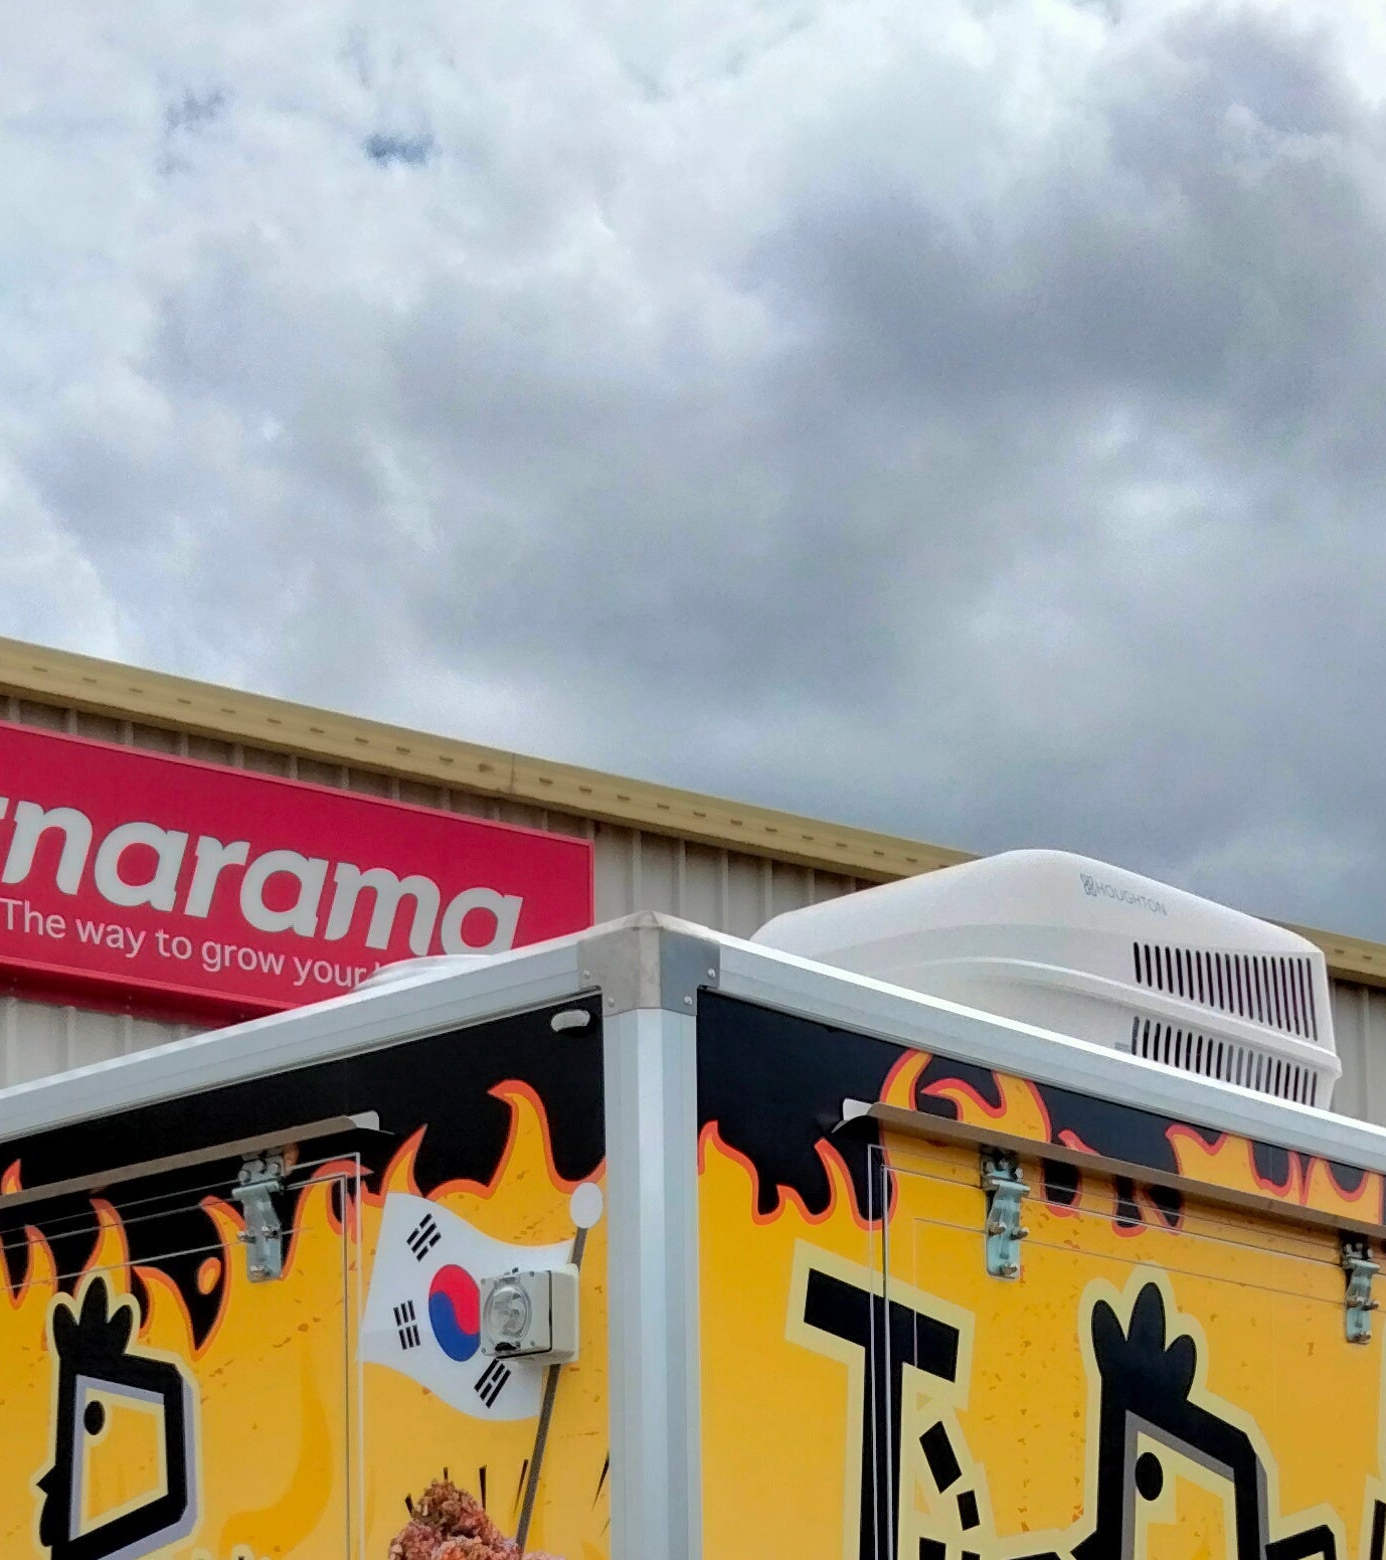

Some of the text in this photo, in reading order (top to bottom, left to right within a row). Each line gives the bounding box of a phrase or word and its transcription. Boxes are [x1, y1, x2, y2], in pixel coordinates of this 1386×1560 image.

[75, 918, 146, 958] way
[155, 928, 192, 960] to
[201, 940, 286, 976] grow
[293, 955, 366, 988] your
